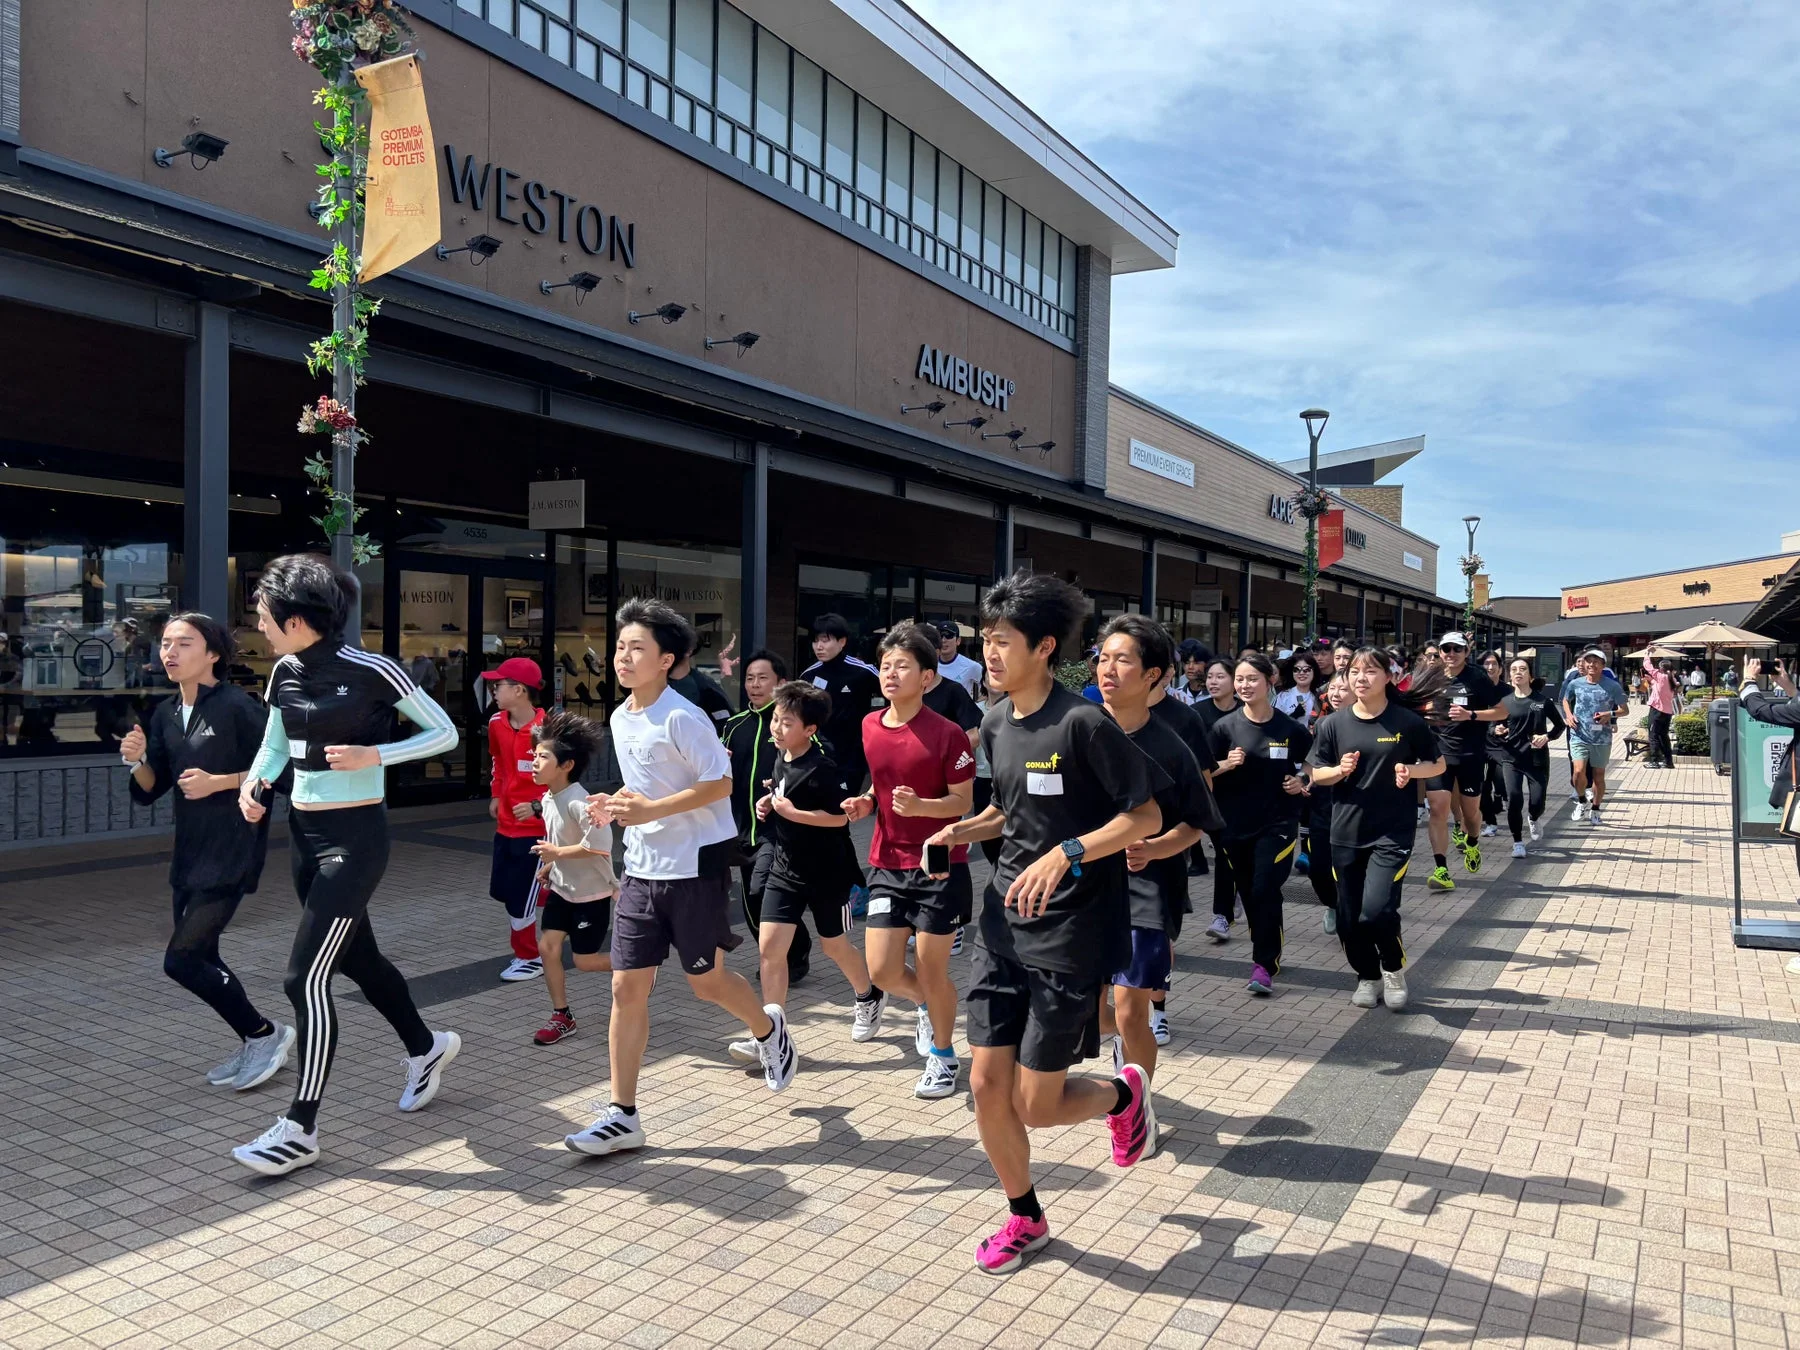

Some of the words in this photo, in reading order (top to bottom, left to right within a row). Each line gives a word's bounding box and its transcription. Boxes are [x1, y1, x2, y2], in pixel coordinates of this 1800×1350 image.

[381, 125, 423, 141] GOTEMBA
[383, 139, 424, 153] PREMIUM
[382, 152, 426, 166] OUTLETS
[443, 144, 635, 269] WESTON
[1133, 447, 1159, 467] PREMIUM
[411, 590, 454, 604] WESTON
[1038, 779, 1047, 791] A
